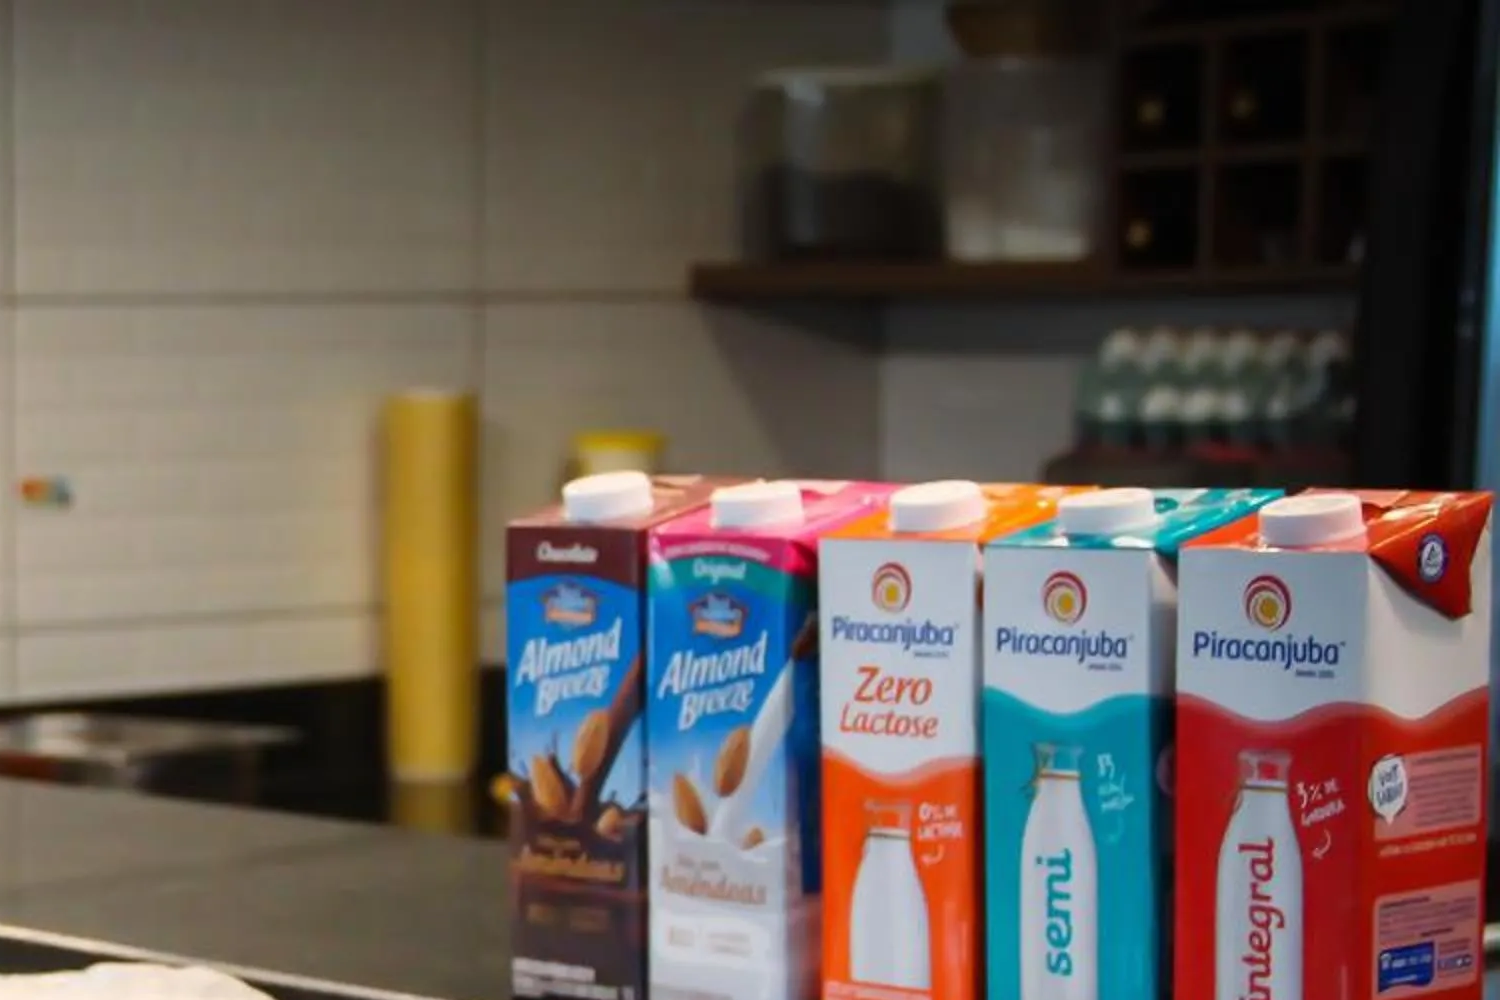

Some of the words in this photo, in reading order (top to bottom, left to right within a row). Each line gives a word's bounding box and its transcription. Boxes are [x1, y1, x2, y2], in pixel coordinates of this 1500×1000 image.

[515, 616, 623, 687] Almond
[832, 616, 954, 651] Piracanjuba
[996, 627, 1128, 664] Piracanjuba
[1193, 631, 1340, 670] Piracanjuba
[657, 629, 768, 700] Almond
[854, 665, 933, 706] Zero
[534, 662, 611, 718] Breeze
[678, 677, 755, 730] Breeze
[838, 702, 939, 739] Lactose
[1036, 847, 1073, 978] semi
